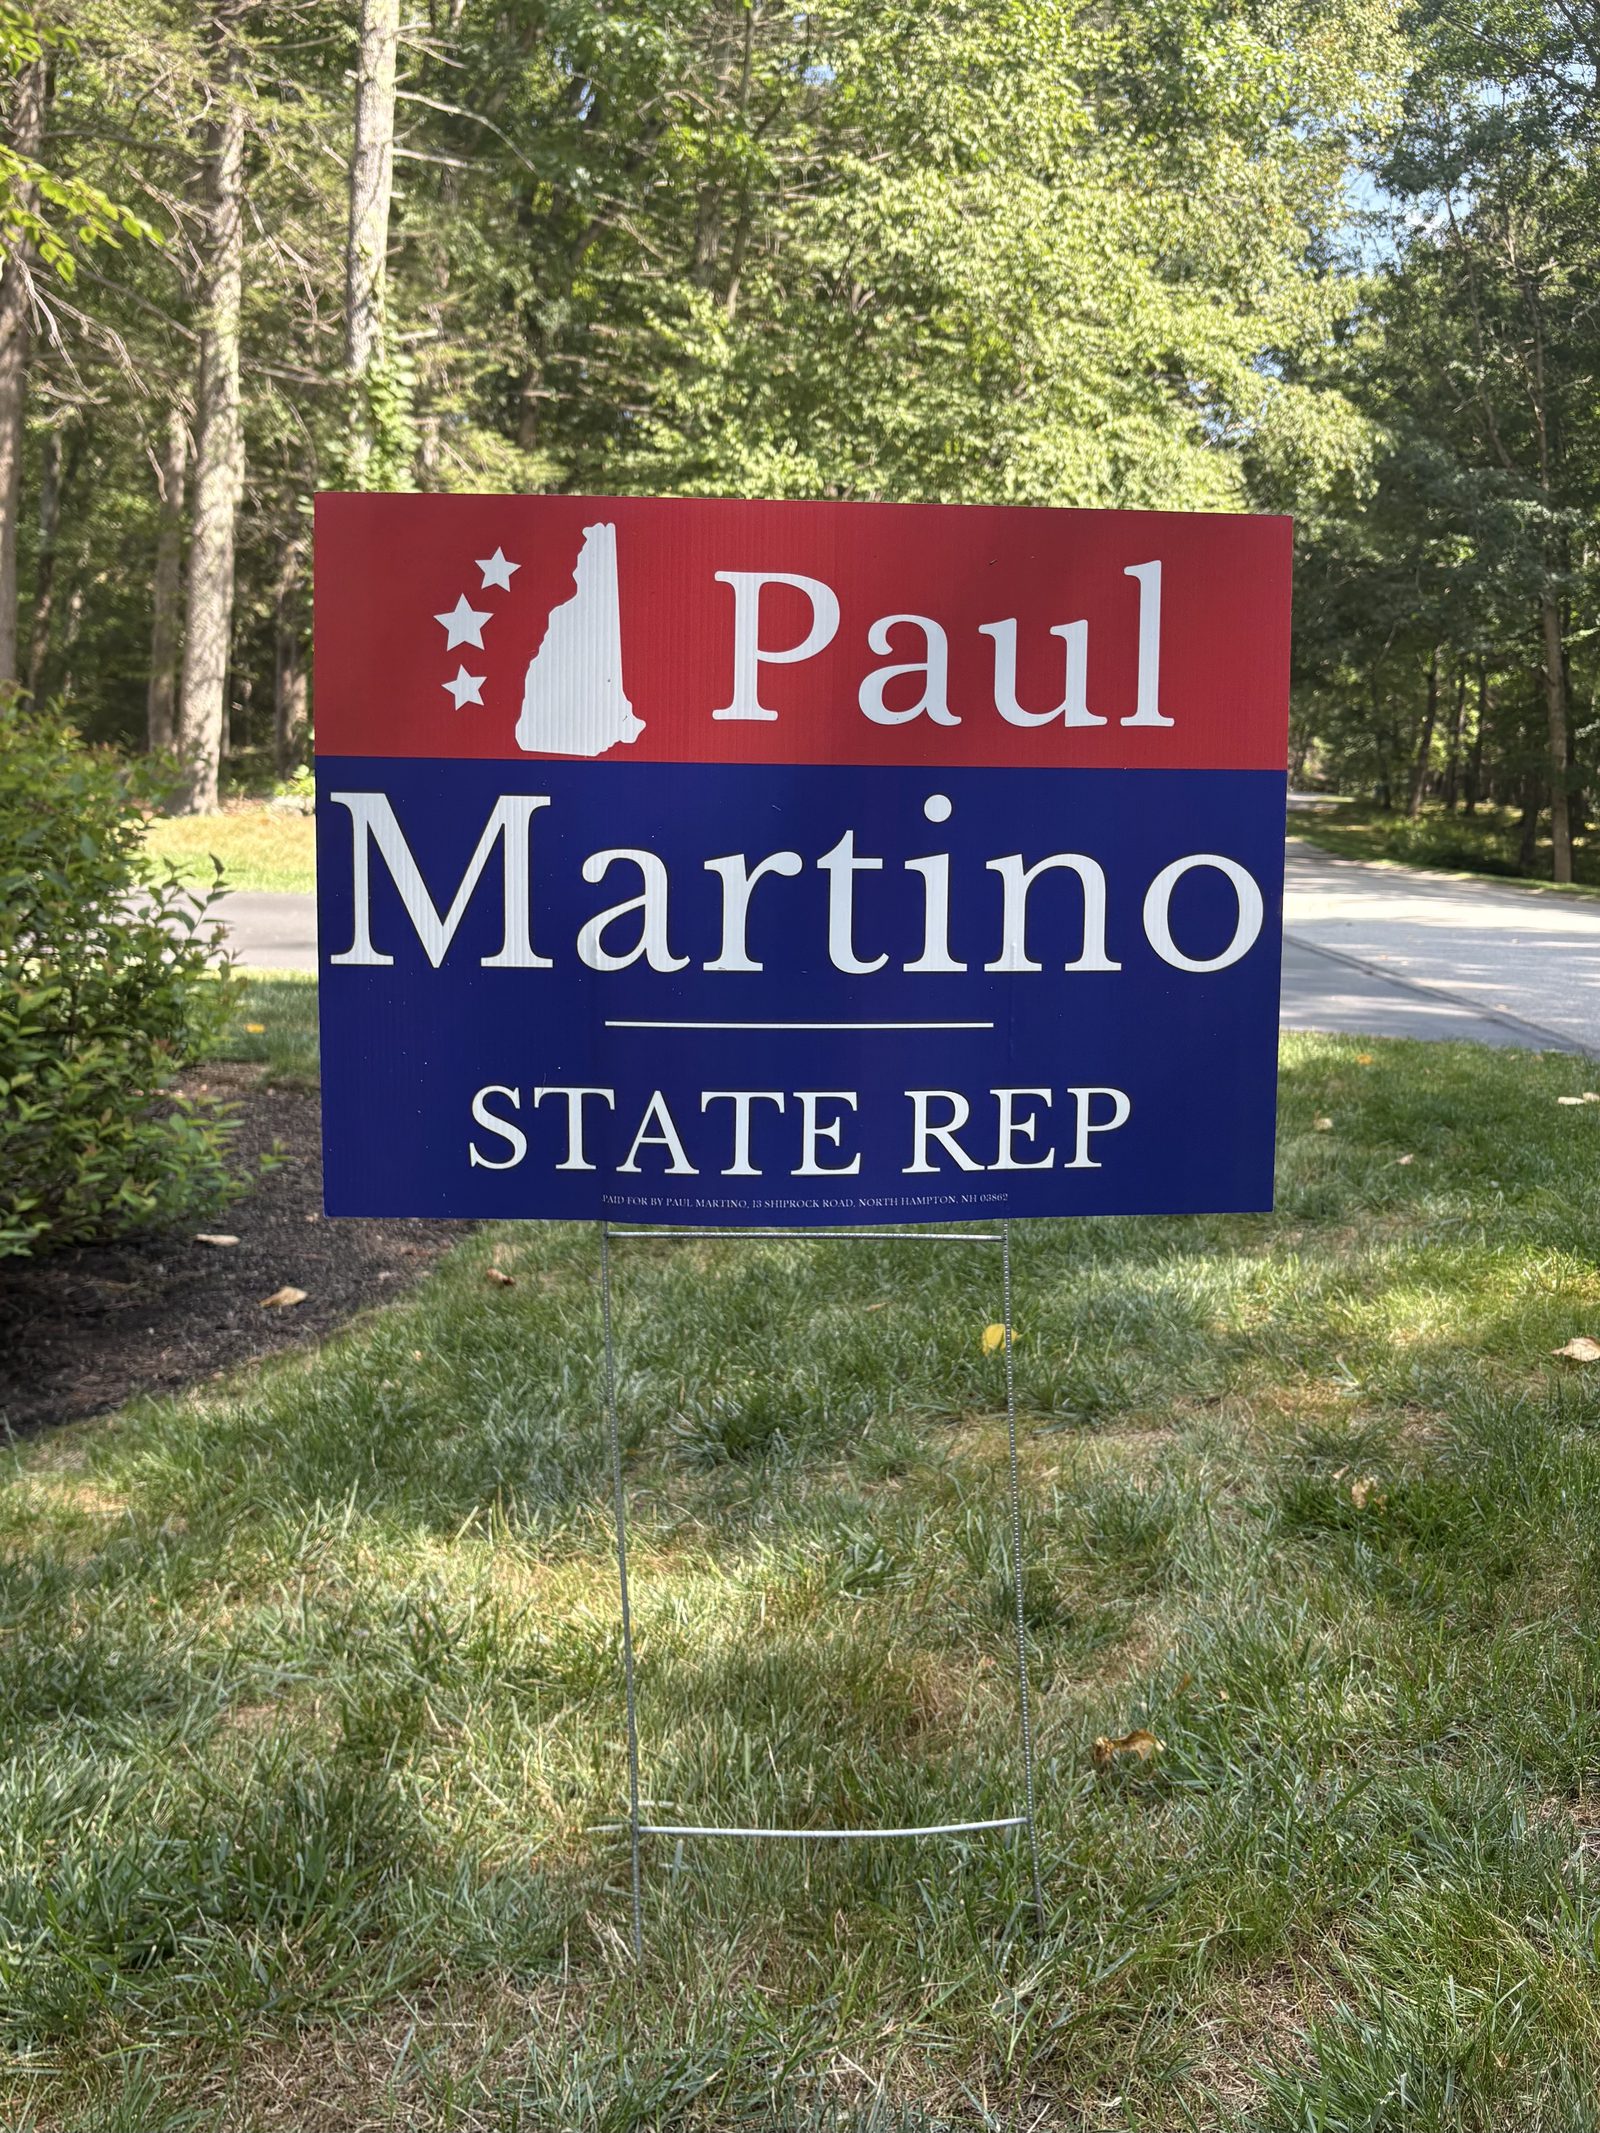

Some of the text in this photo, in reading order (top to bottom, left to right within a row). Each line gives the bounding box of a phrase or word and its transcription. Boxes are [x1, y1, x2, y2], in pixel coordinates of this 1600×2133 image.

[711, 558, 1176, 729] Paul
[329, 791, 1265, 975] Martino
[468, 1084, 1132, 1176] STATE REP
[602, 1194, 625, 1205] PAID
[627, 1196, 648, 1206] FOR
[650, 1197, 664, 1207] BY
[666, 1198, 693, 1208] PAUL
[695, 1198, 750, 1209] MARTINO,
[752, 1199, 762, 1208] 13
[764, 1199, 820, 1209] SHIPROCK
[858, 1197, 899, 1208] NORTH
[901, 1194, 959, 1206] HAMPTON,
[961, 1193, 977, 1203] NH
[979, 1192, 1009, 1203] 03862
